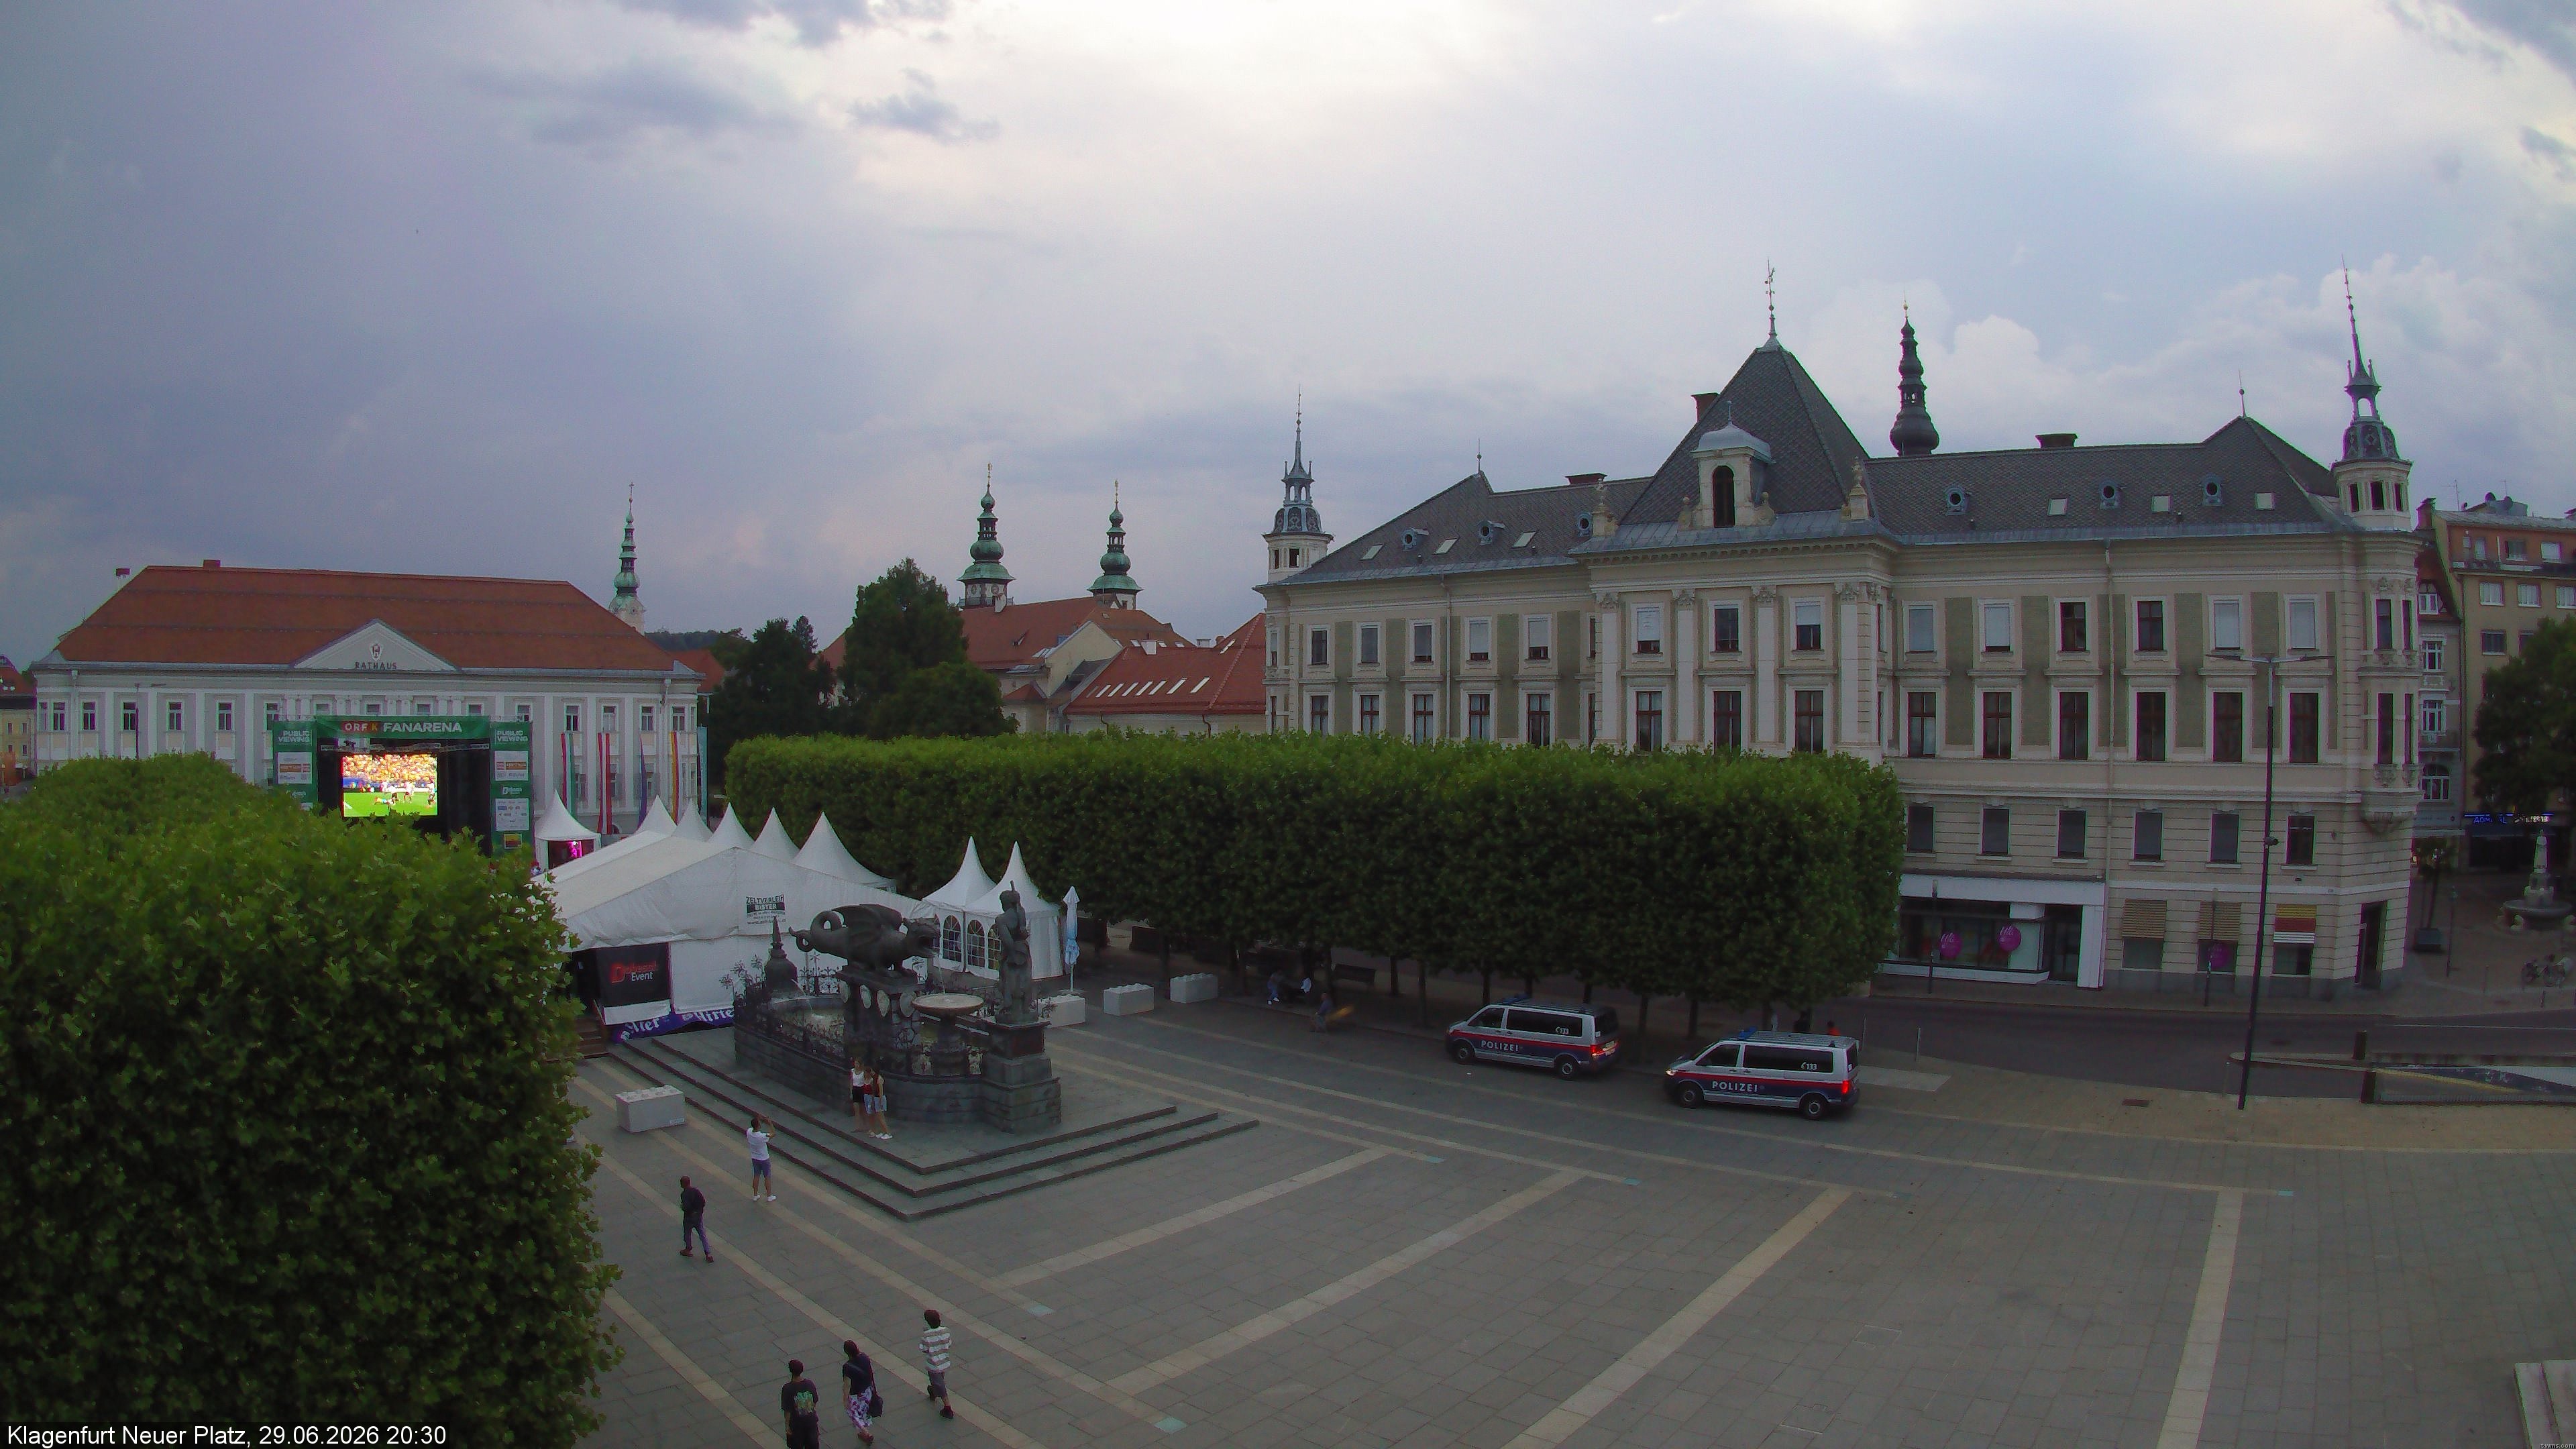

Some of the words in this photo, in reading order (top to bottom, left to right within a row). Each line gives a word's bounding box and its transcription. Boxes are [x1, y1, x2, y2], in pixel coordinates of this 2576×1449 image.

[355, 661, 397, 670] RATHAUS
[345, 722, 368, 731] ORF
[383, 722, 462, 733] FANARENA
[631, 971, 653, 981] Event
[1481, 1040, 1519, 1052] POLIZEI
[1806, 1063, 1817, 1071] 133
[1711, 1081, 1758, 1092] POLIZEI
